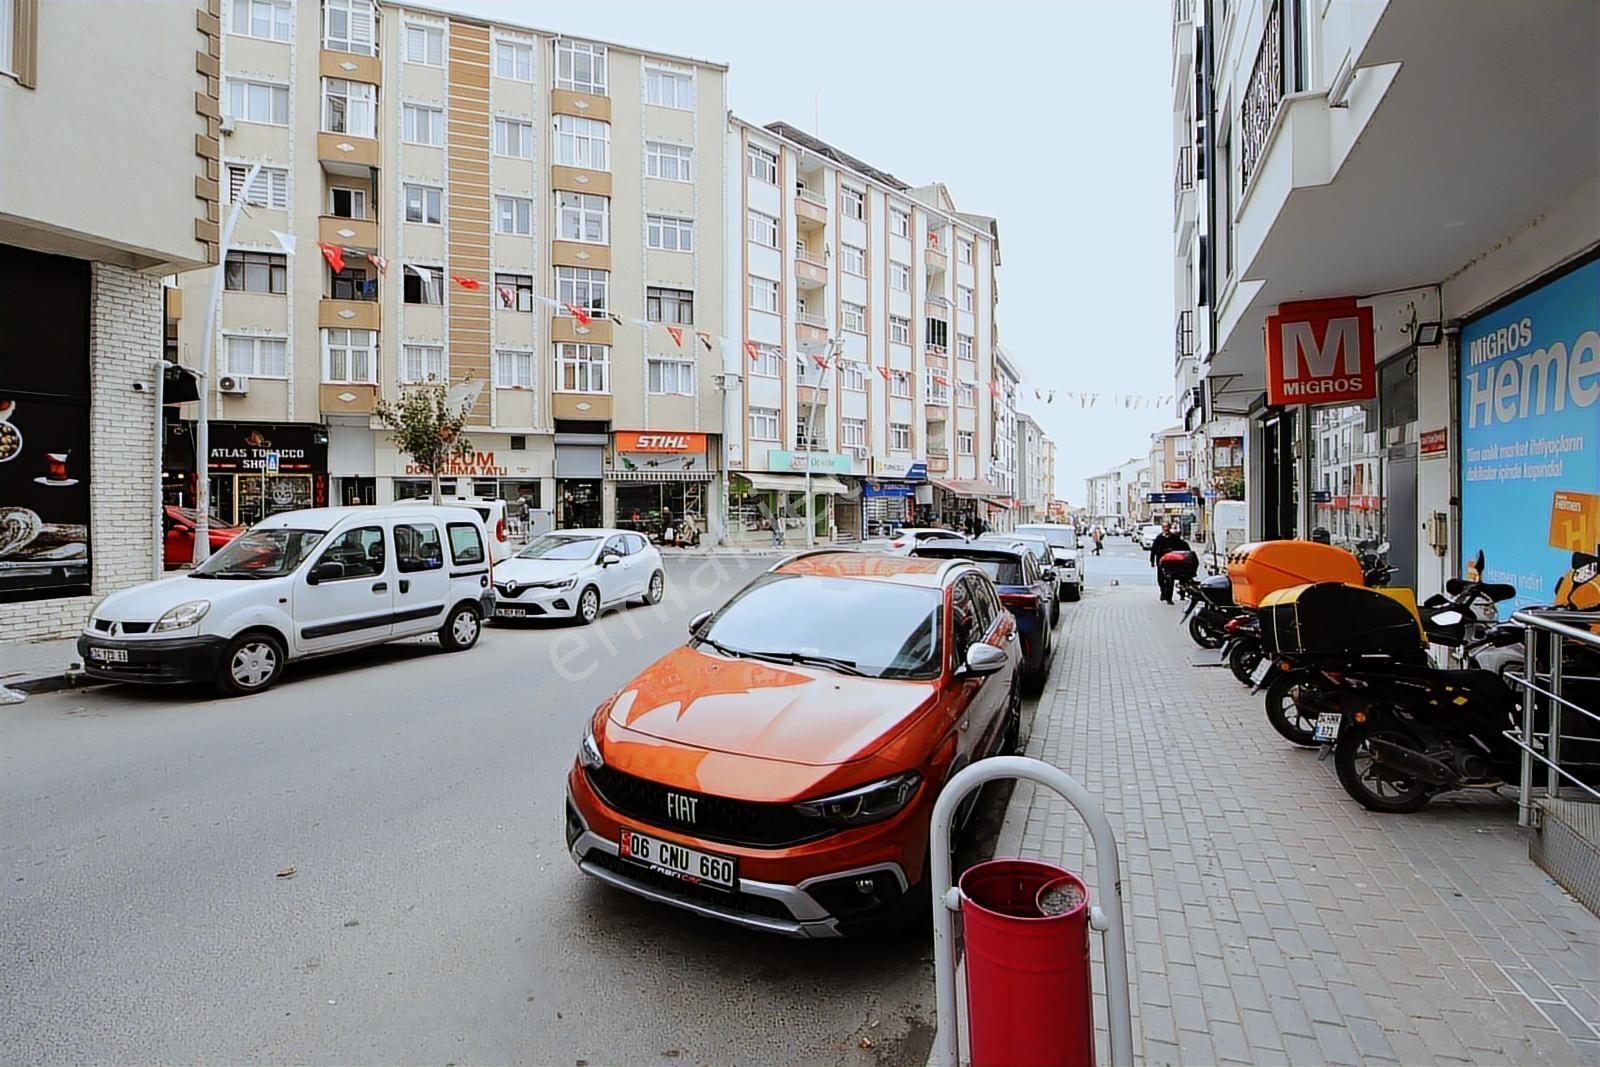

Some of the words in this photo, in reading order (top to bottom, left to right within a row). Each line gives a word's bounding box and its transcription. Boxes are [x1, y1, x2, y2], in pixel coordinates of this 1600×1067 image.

[1281, 317, 1361, 380] M
[211, 449, 247, 458] ATLAS
[636, 435, 689, 449] STIHL
[667, 792, 698, 823] FIAT
[631, 835, 650, 858] 06
[660, 844, 690, 871] CNU
[700, 856, 733, 883] 660
